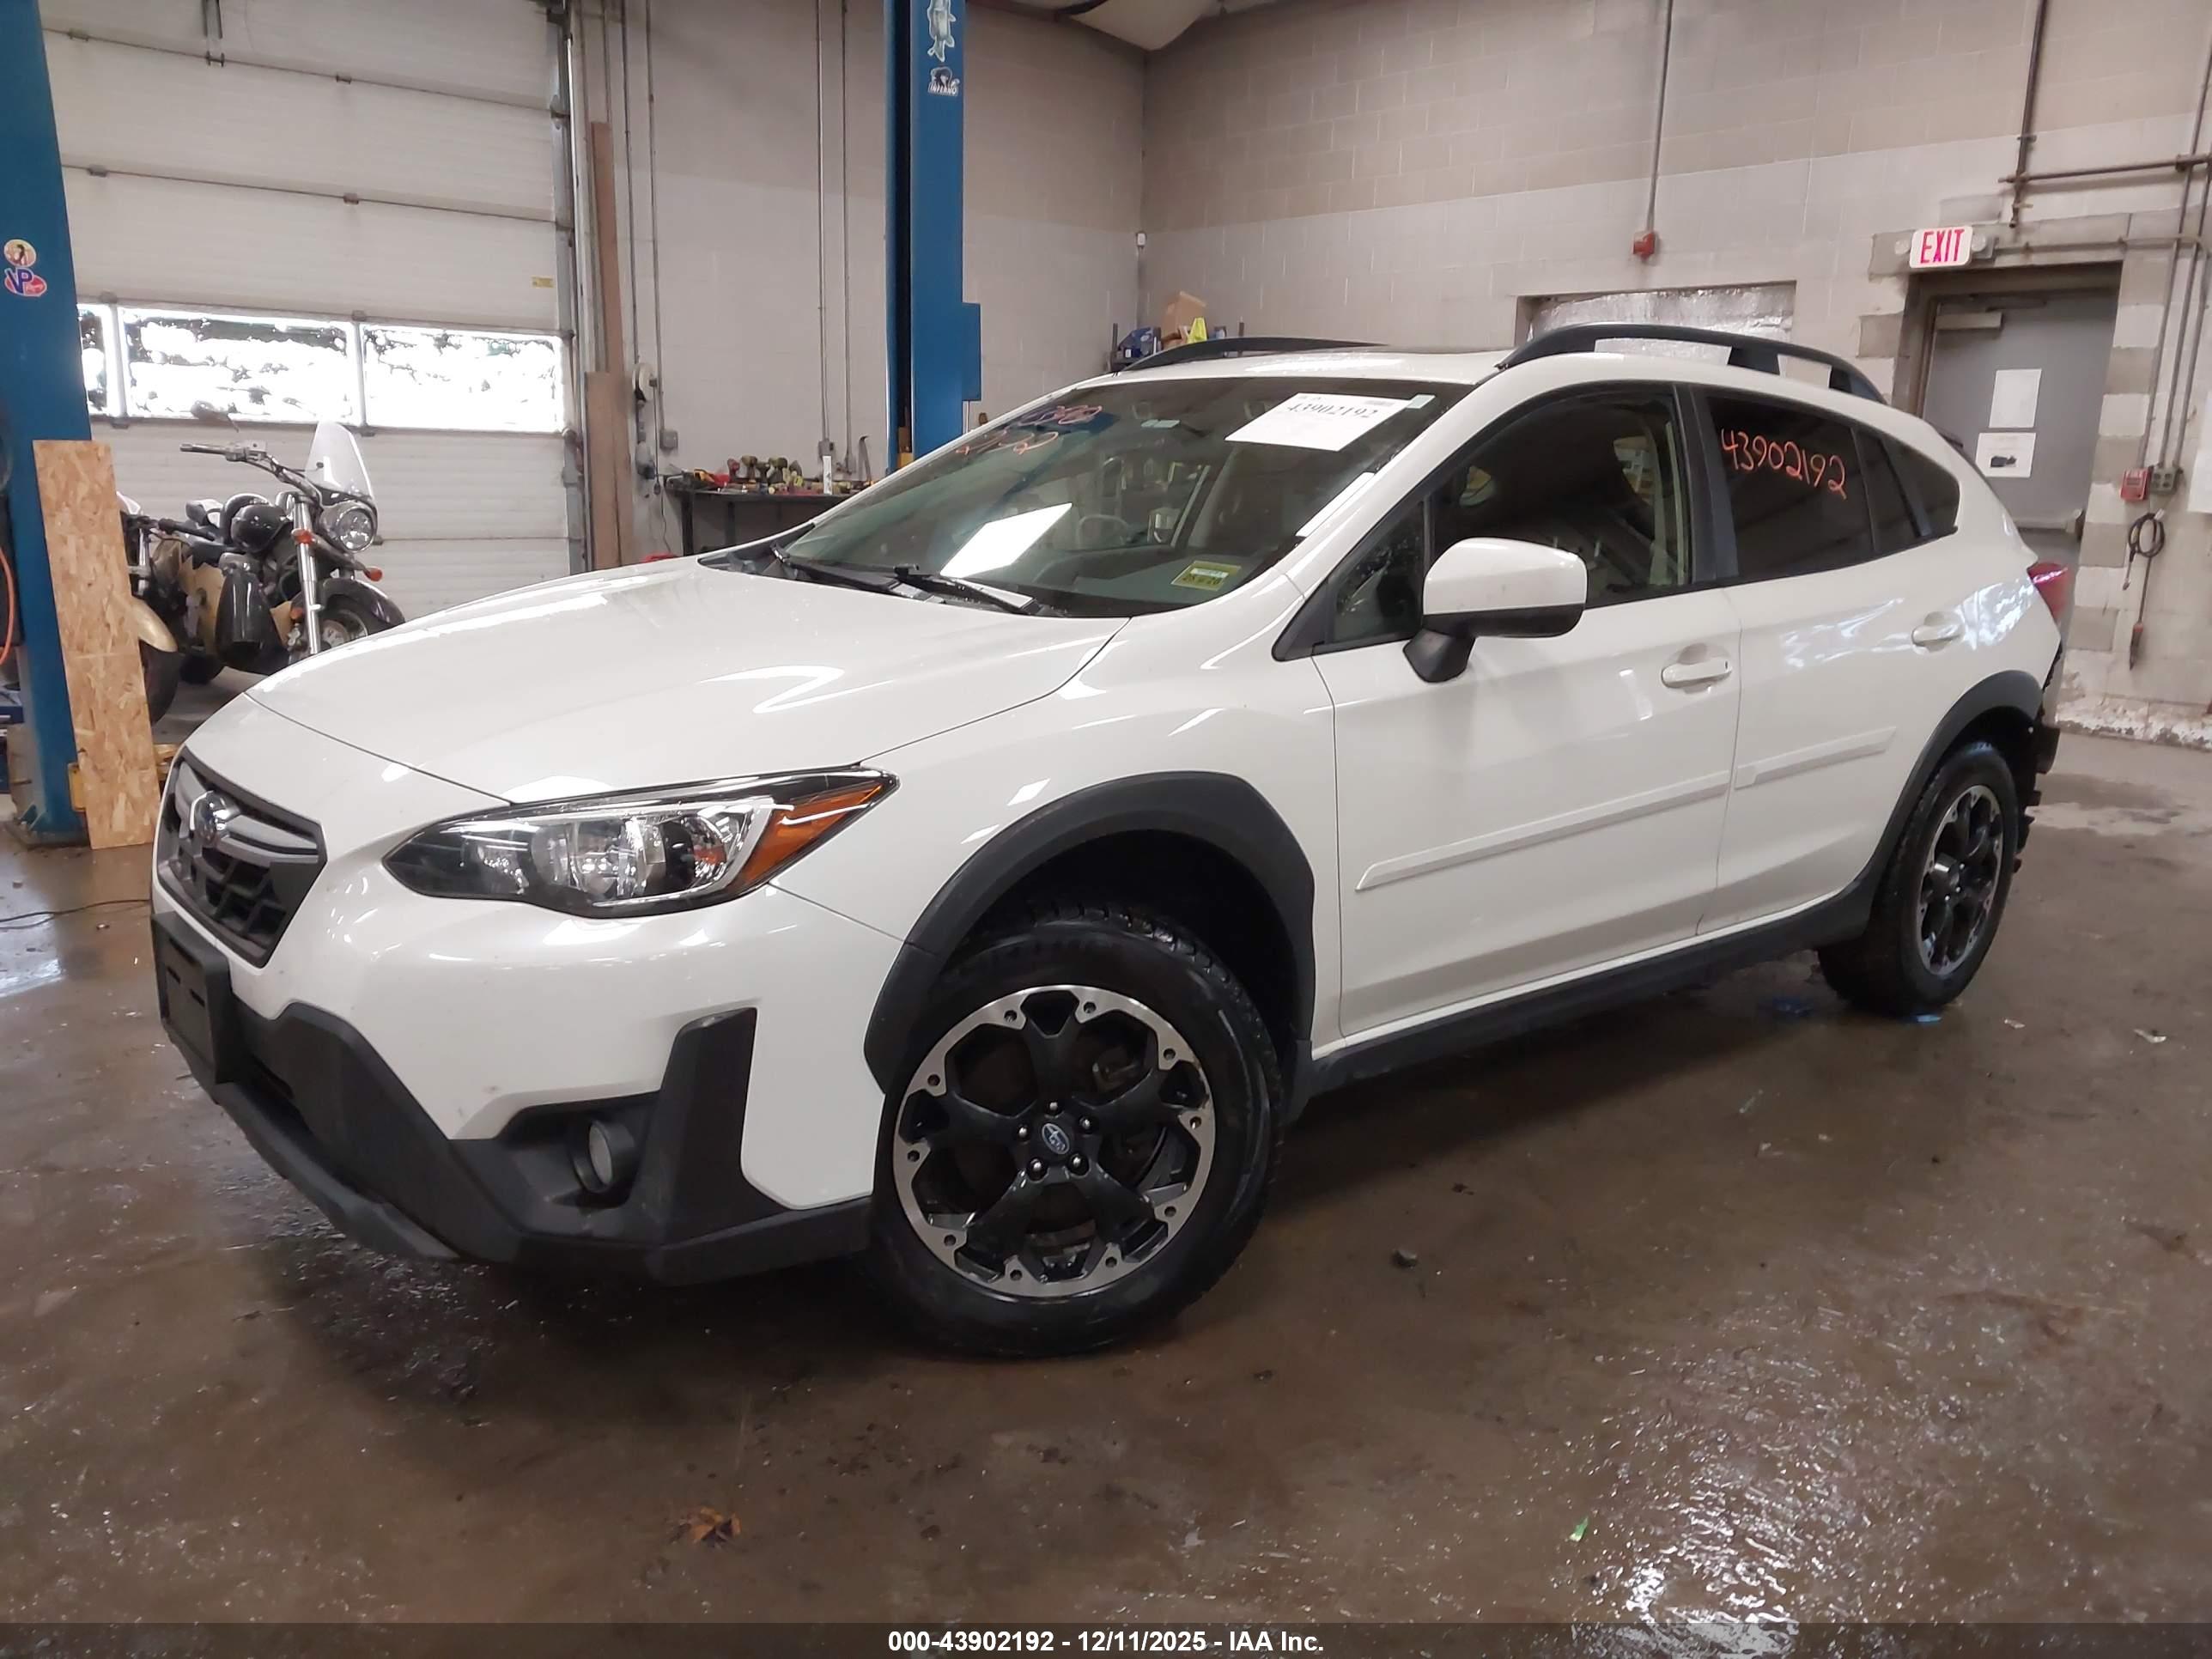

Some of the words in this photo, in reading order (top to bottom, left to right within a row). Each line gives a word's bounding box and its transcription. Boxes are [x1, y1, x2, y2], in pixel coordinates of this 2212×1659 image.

[1920, 228, 1966, 264] EXIT
[6, 268, 33, 294] VP
[1720, 428, 1848, 500] 43902192
